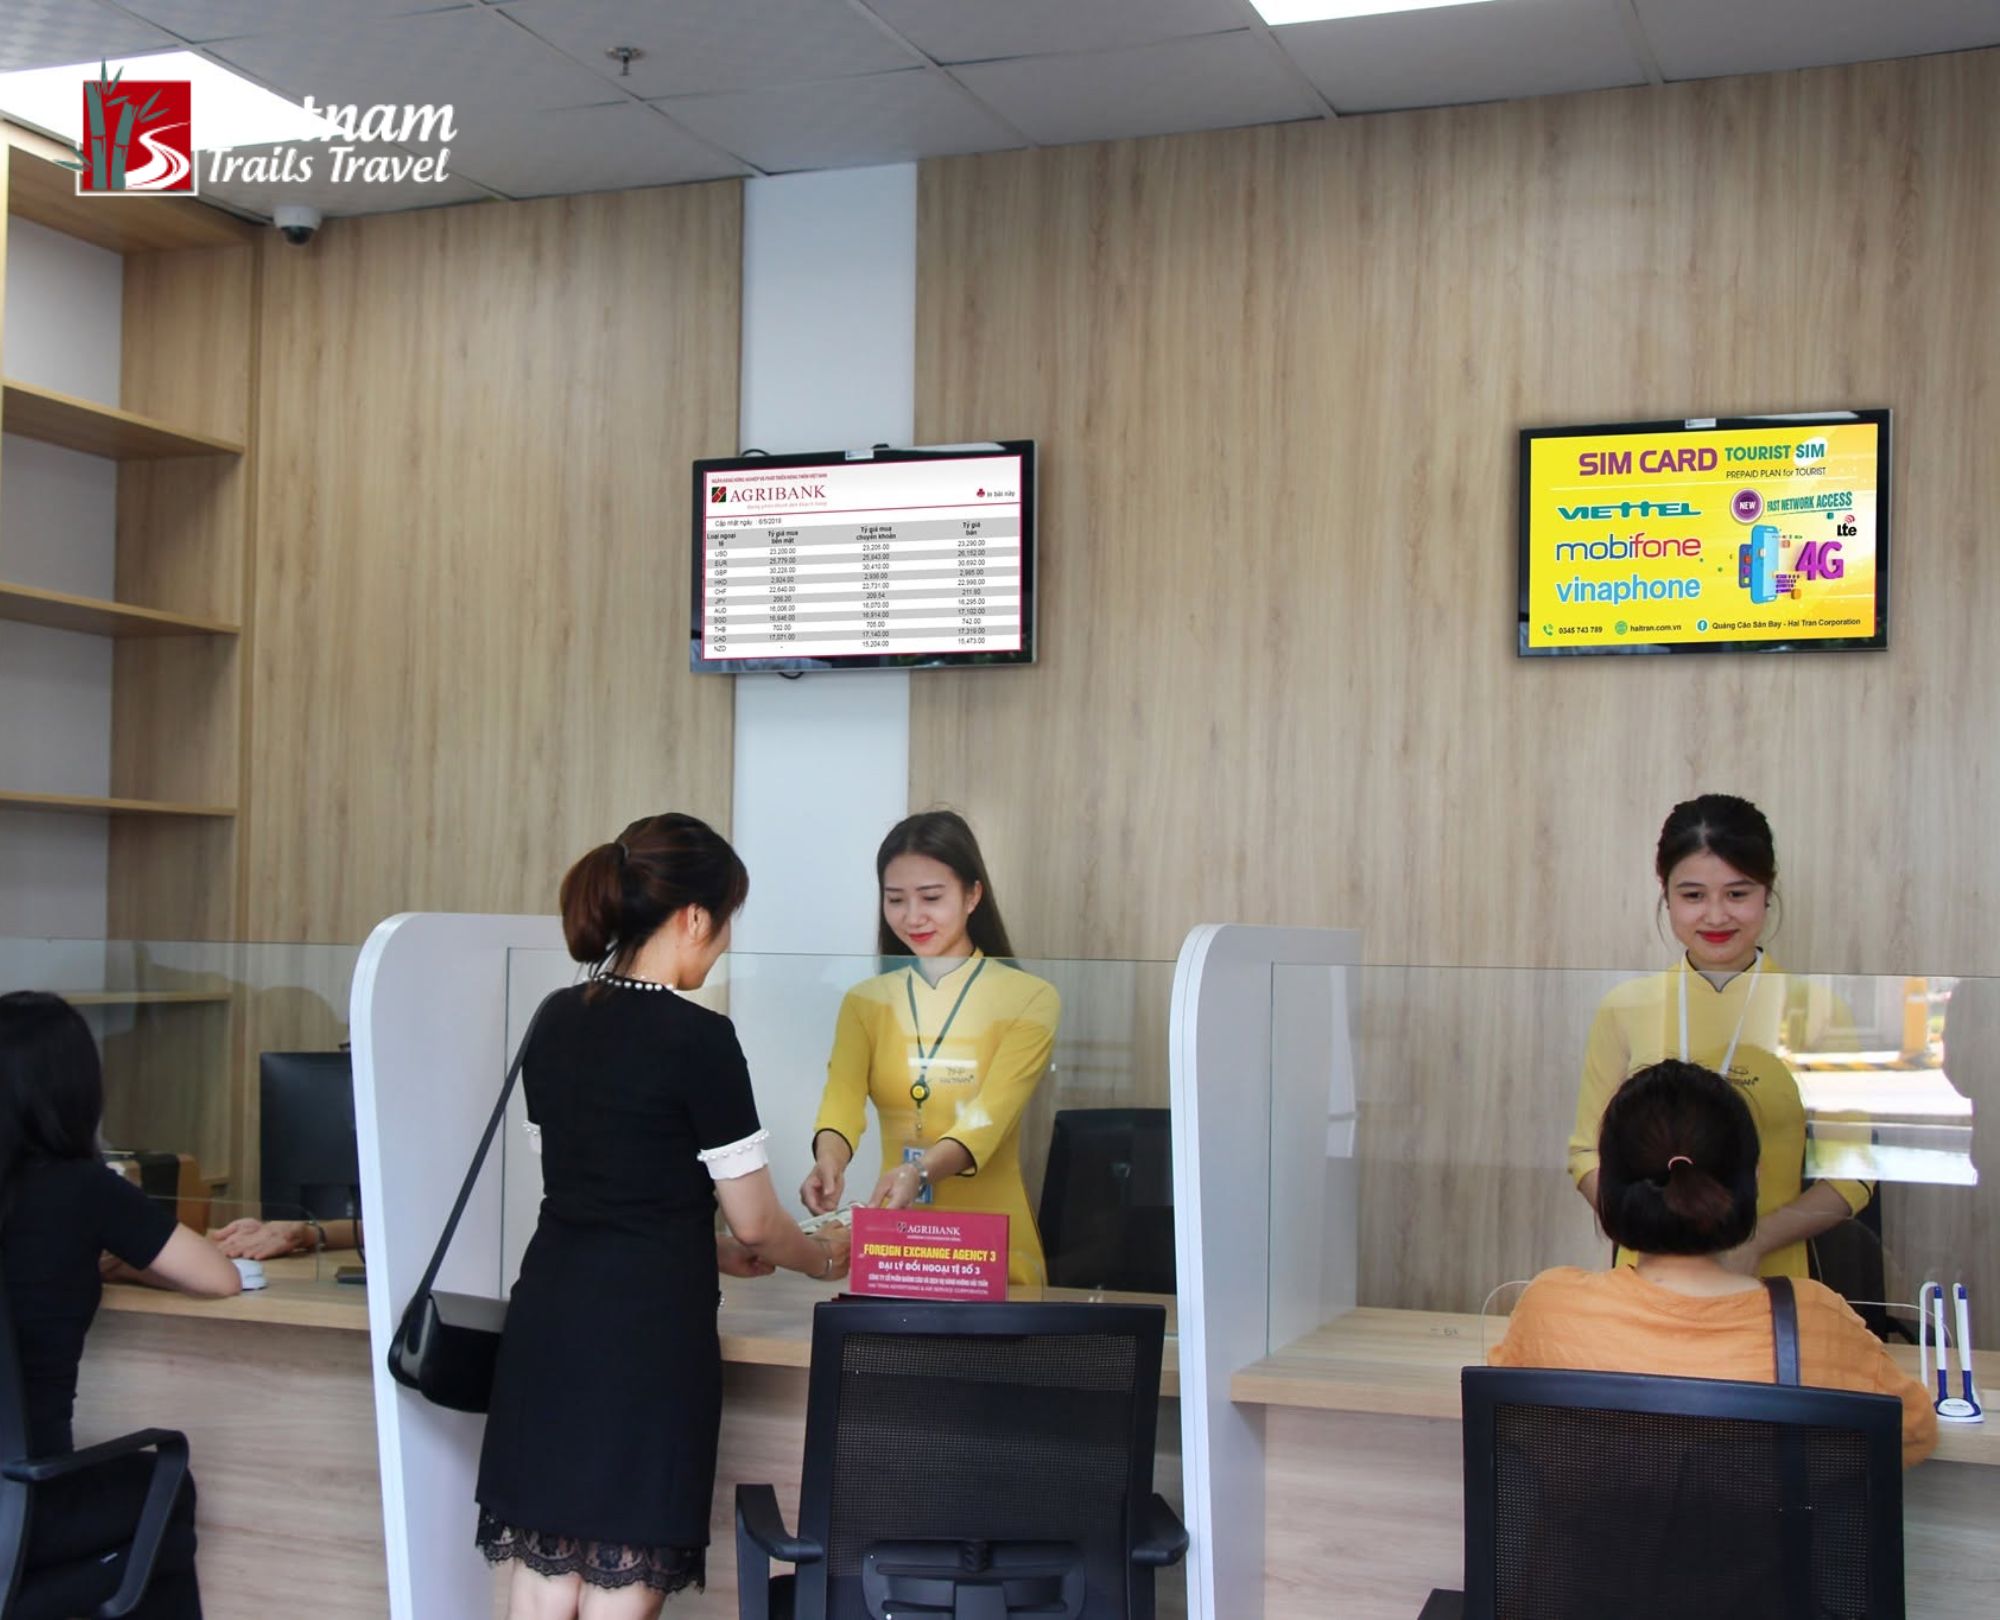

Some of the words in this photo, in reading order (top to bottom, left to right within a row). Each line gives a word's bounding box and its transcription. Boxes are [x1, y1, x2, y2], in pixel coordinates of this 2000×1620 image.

[1579, 451, 1632, 476] SIM
[1639, 448, 1718, 474] CARD
[1725, 445, 1791, 462] TOURIST
[1796, 443, 1825, 459] SIM
[1726, 470, 1759, 479] PREPAID
[1760, 469, 1781, 478] PLAN
[1783, 468, 1794, 476] for
[1796, 466, 1826, 476] TOURIST
[730, 485, 826, 503] AGRIBANK
[1767, 500, 1780, 512] FAST
[1781, 496, 1814, 510] NETWORK
[1816, 491, 1853, 507] ACCESS
[1739, 501, 1756, 510] NEW
[1556, 532, 1702, 561] mobifone
[1795, 541, 1844, 581] 4G
[1556, 574, 1701, 605] vinaphone
[1558, 626, 1575, 635] 0345
[1768, 619, 1782, 629] Bay
[1801, 618, 1817, 626] Tran
[1818, 617, 1861, 628] Corporation
[907, 1225, 961, 1236] AGRIBANK
[864, 1243, 901, 1257] FOREIGN
[903, 1245, 950, 1259] EXCHANGE
[952, 1248, 988, 1261] AGENCY
[990, 1250, 996, 1262] 3
